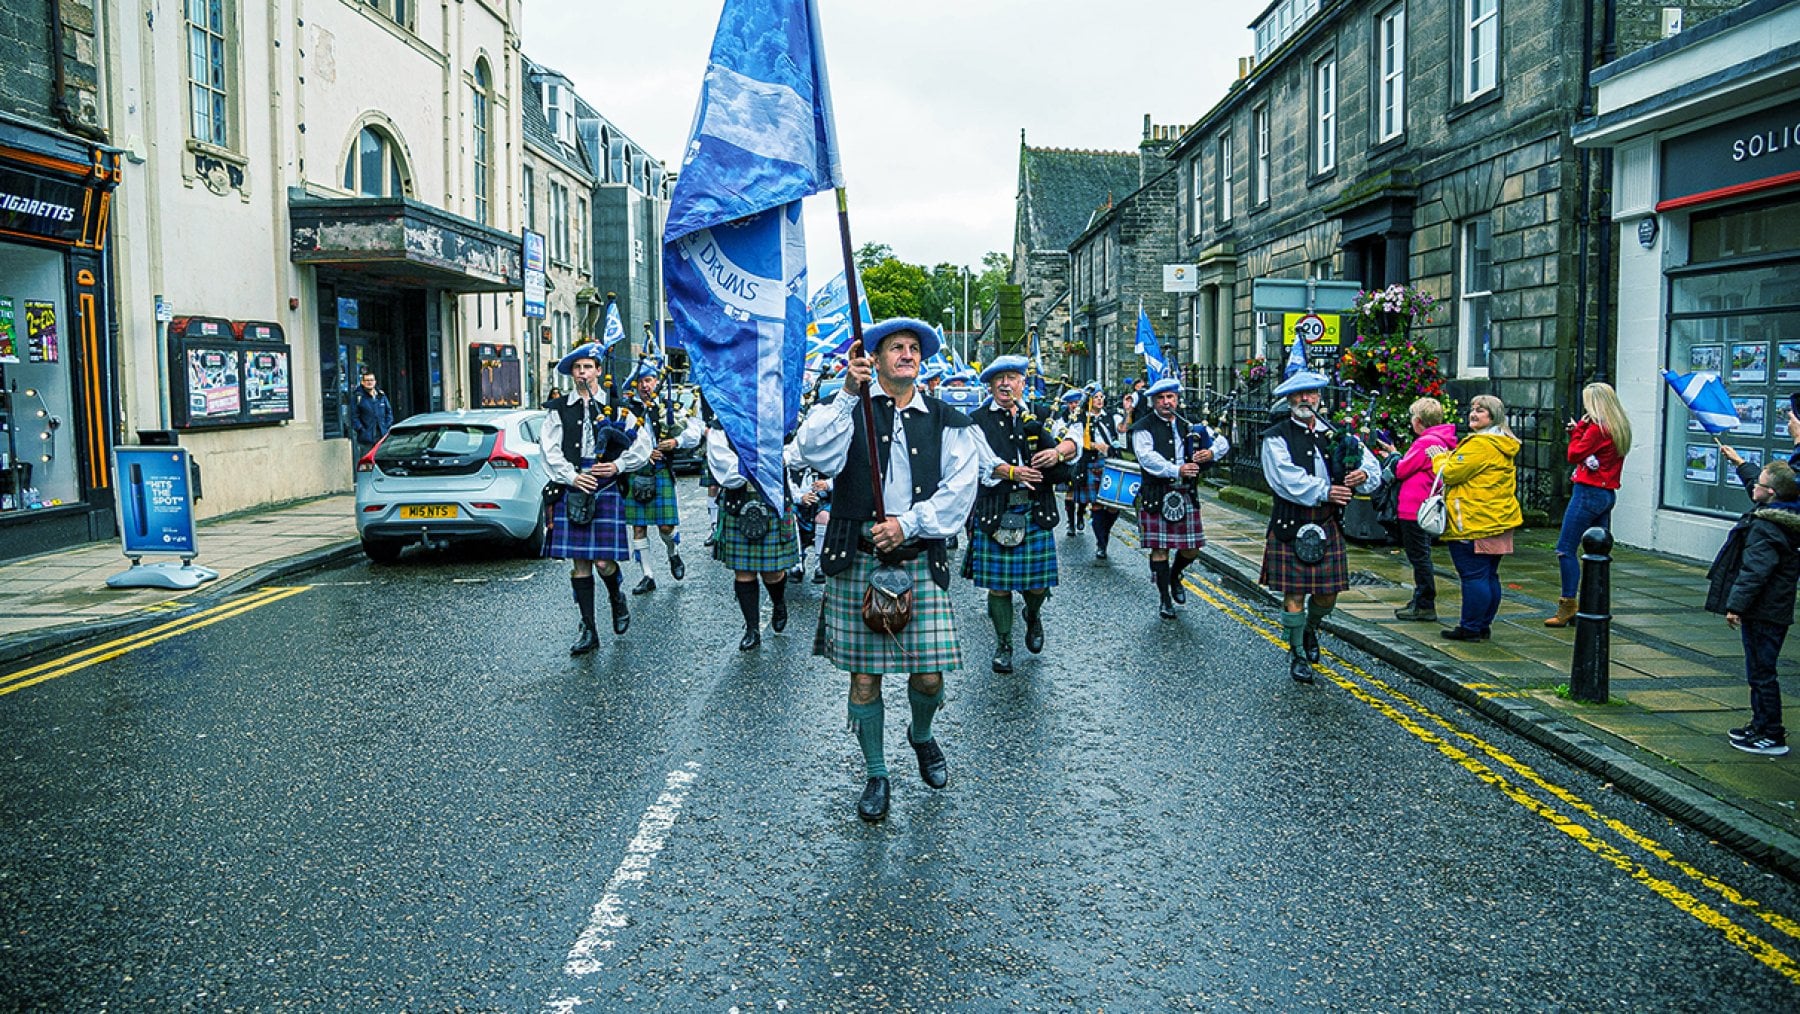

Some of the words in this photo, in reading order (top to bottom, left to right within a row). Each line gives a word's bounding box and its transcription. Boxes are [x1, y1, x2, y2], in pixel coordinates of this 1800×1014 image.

[700, 242, 759, 300] DRUMS
[1302, 322, 1322, 335] 20
[152, 489, 171, 497] THE
[428, 506, 448, 516] NTS
